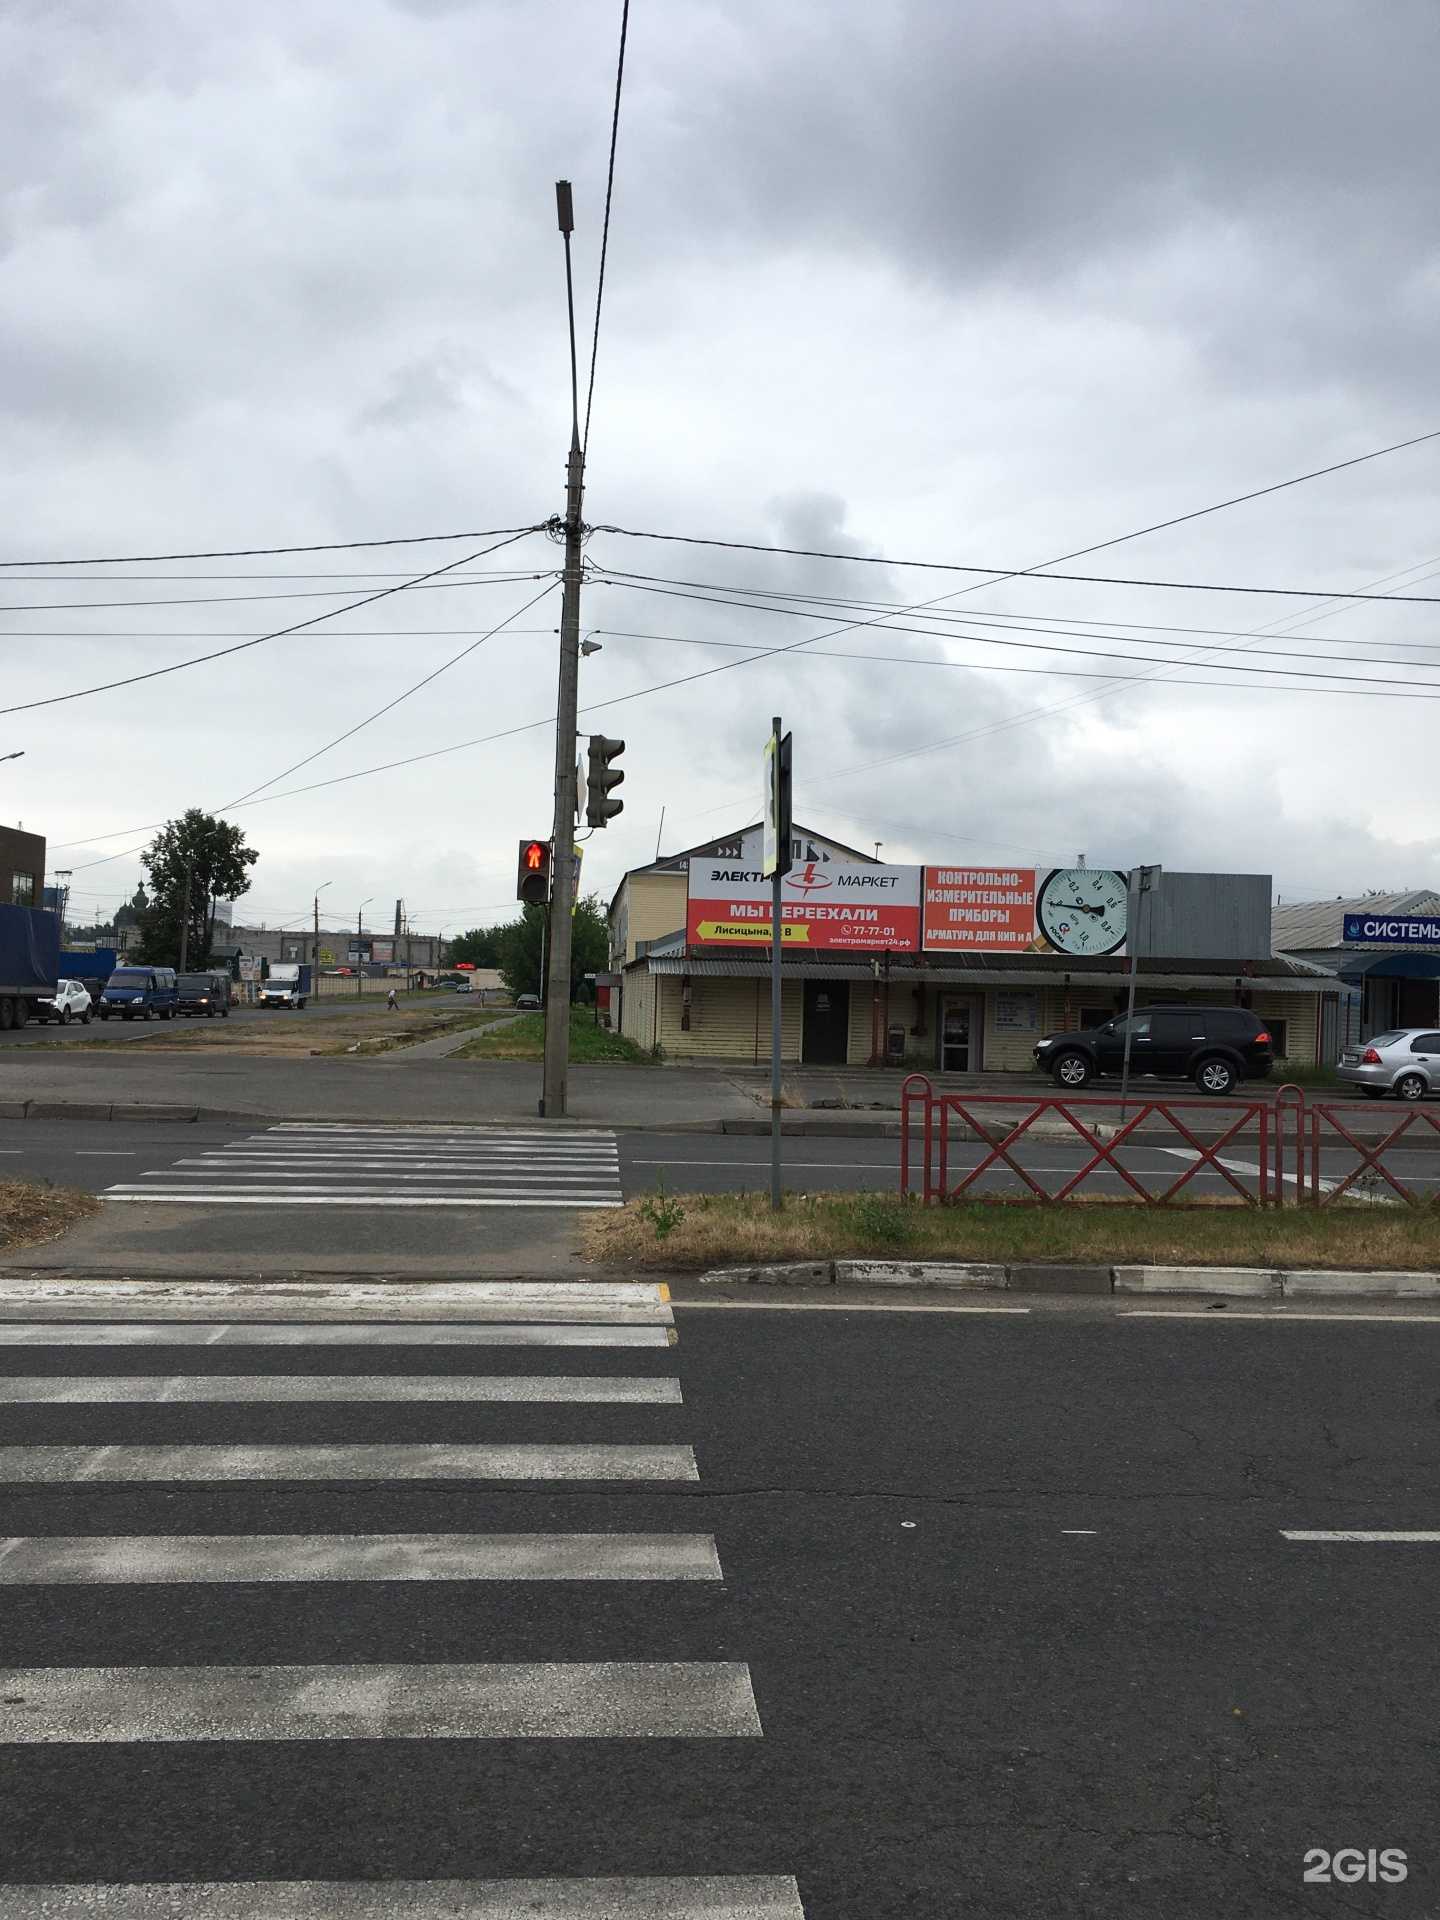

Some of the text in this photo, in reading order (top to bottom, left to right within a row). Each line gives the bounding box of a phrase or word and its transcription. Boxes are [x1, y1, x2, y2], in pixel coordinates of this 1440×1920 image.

[711, 870, 899, 888] ЭЛЕКТР МАРКЕТ
[937, 871, 1023, 886] КОНТРОЛЬНО-
[927, 889, 1033, 905] ИЗМЕРИТЕЛЬНЫЕ
[730, 904, 763, 918] МЫ
[949, 908, 1010, 923] ПРИБОРЫ
[715, 925, 771, 937] Лисицына,
[853, 926, 895, 936] 77-77-01
[927, 929, 974, 940] АРМАТУРА
[975, 930, 995, 942] ДЛЯ
[998, 931, 1016, 942] КИП
